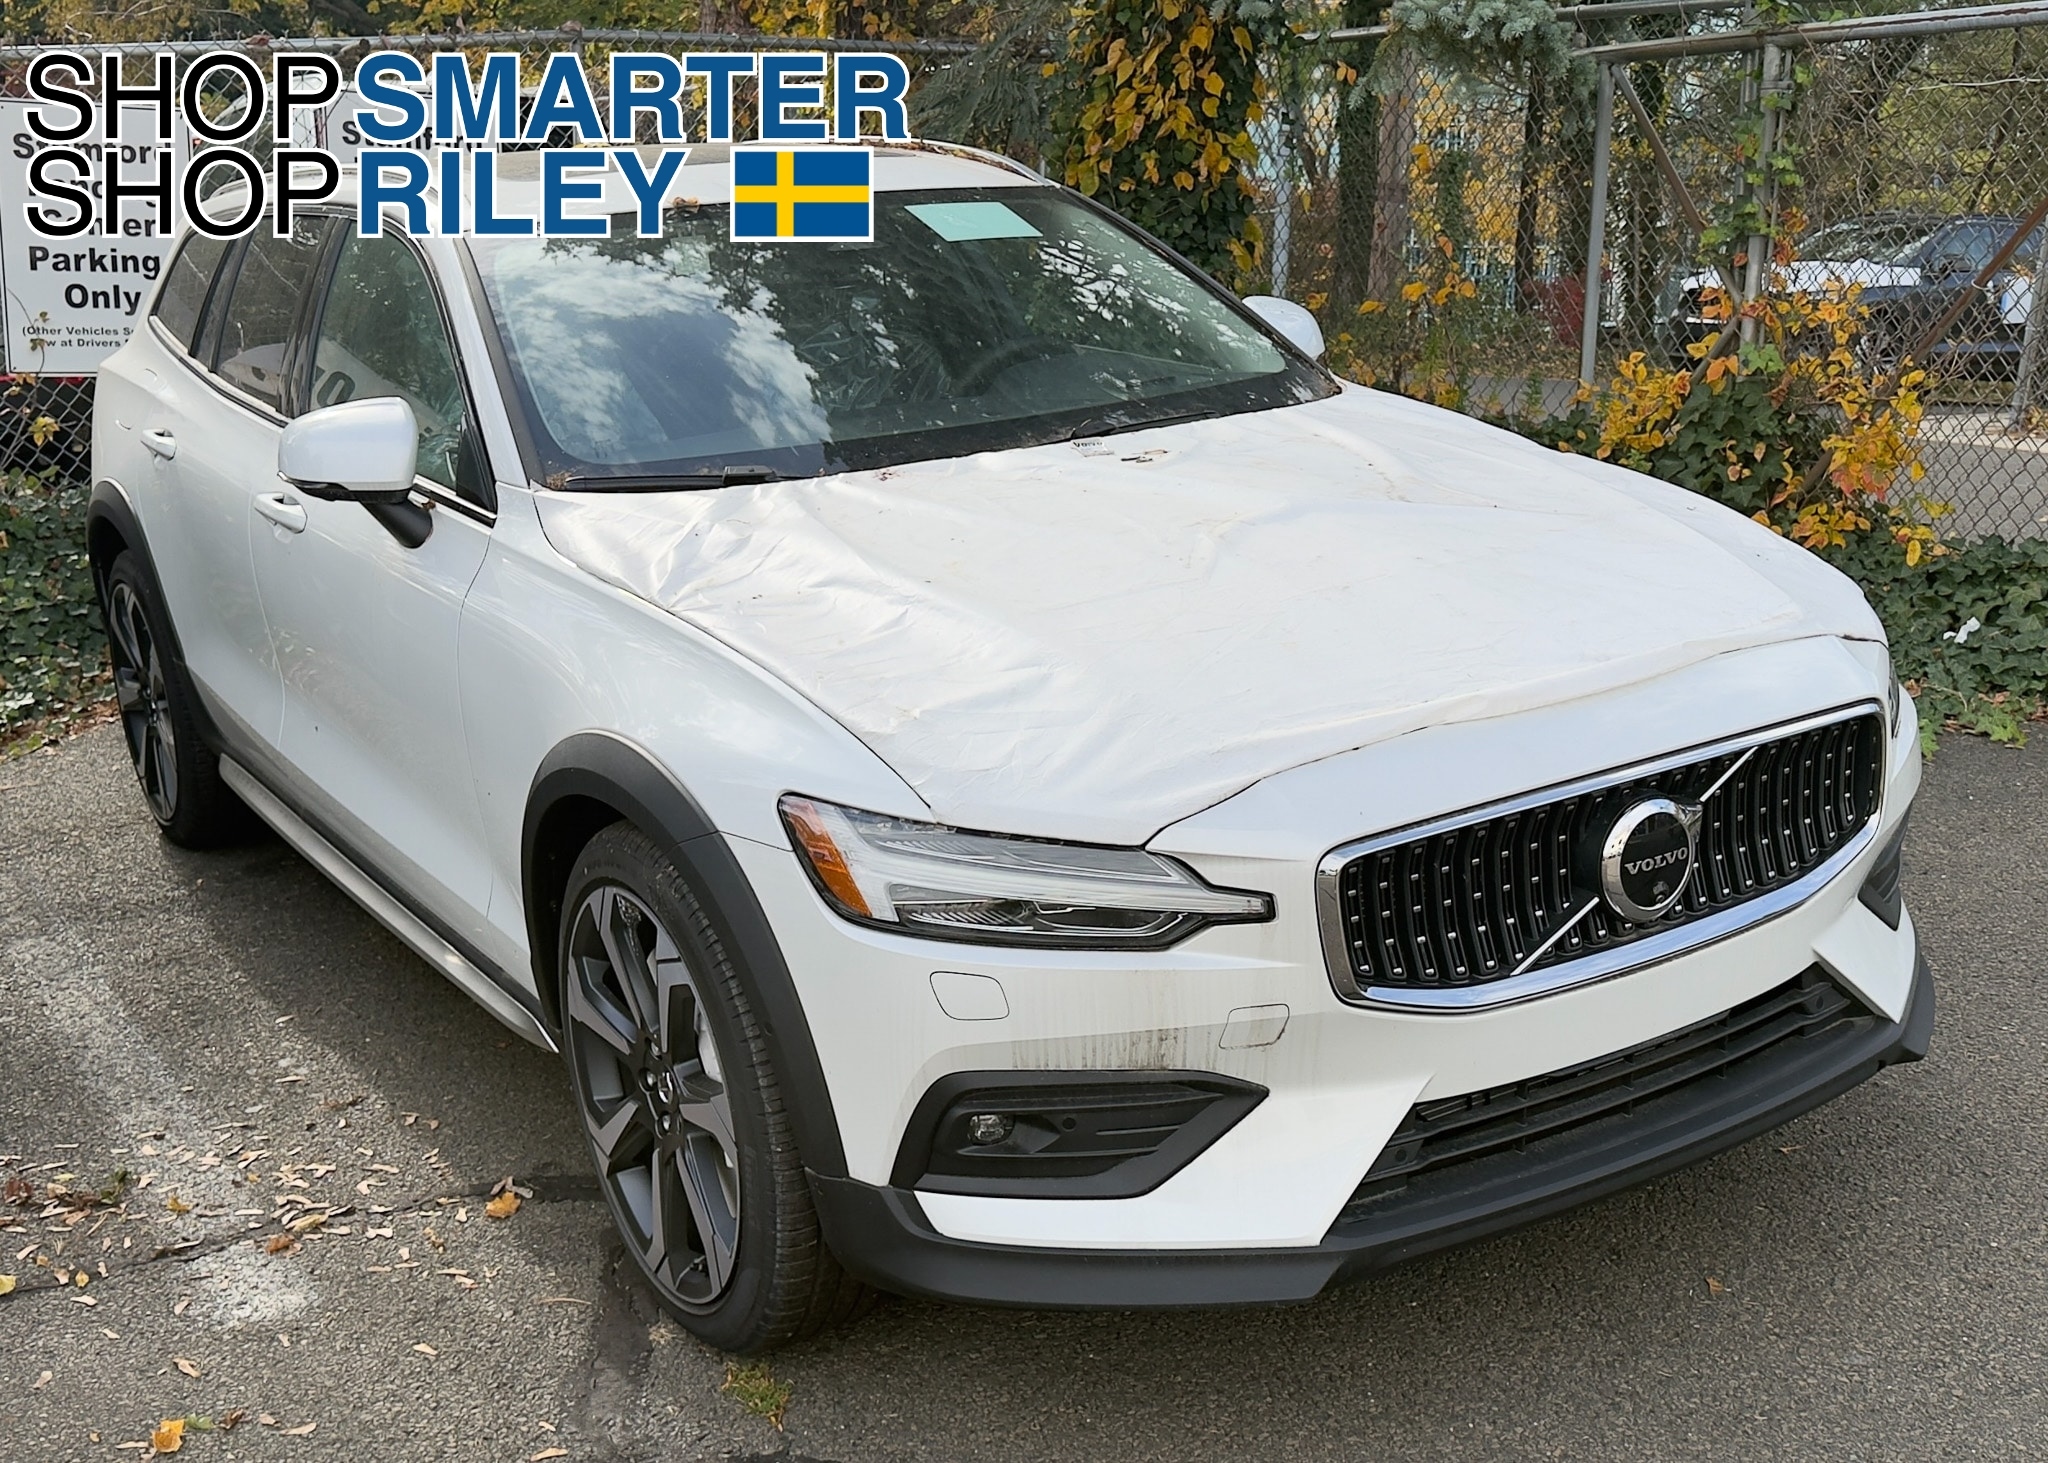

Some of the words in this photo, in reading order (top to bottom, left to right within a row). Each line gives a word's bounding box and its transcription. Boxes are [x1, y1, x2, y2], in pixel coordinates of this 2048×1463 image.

[29, 246, 160, 280] Parking
[65, 283, 141, 316] Only
[61, 339, 72, 348] at
[77, 338, 121, 348] Drivers
[66, 326, 119, 336] Vehicles
[1624, 847, 1688, 875] VOLVO
